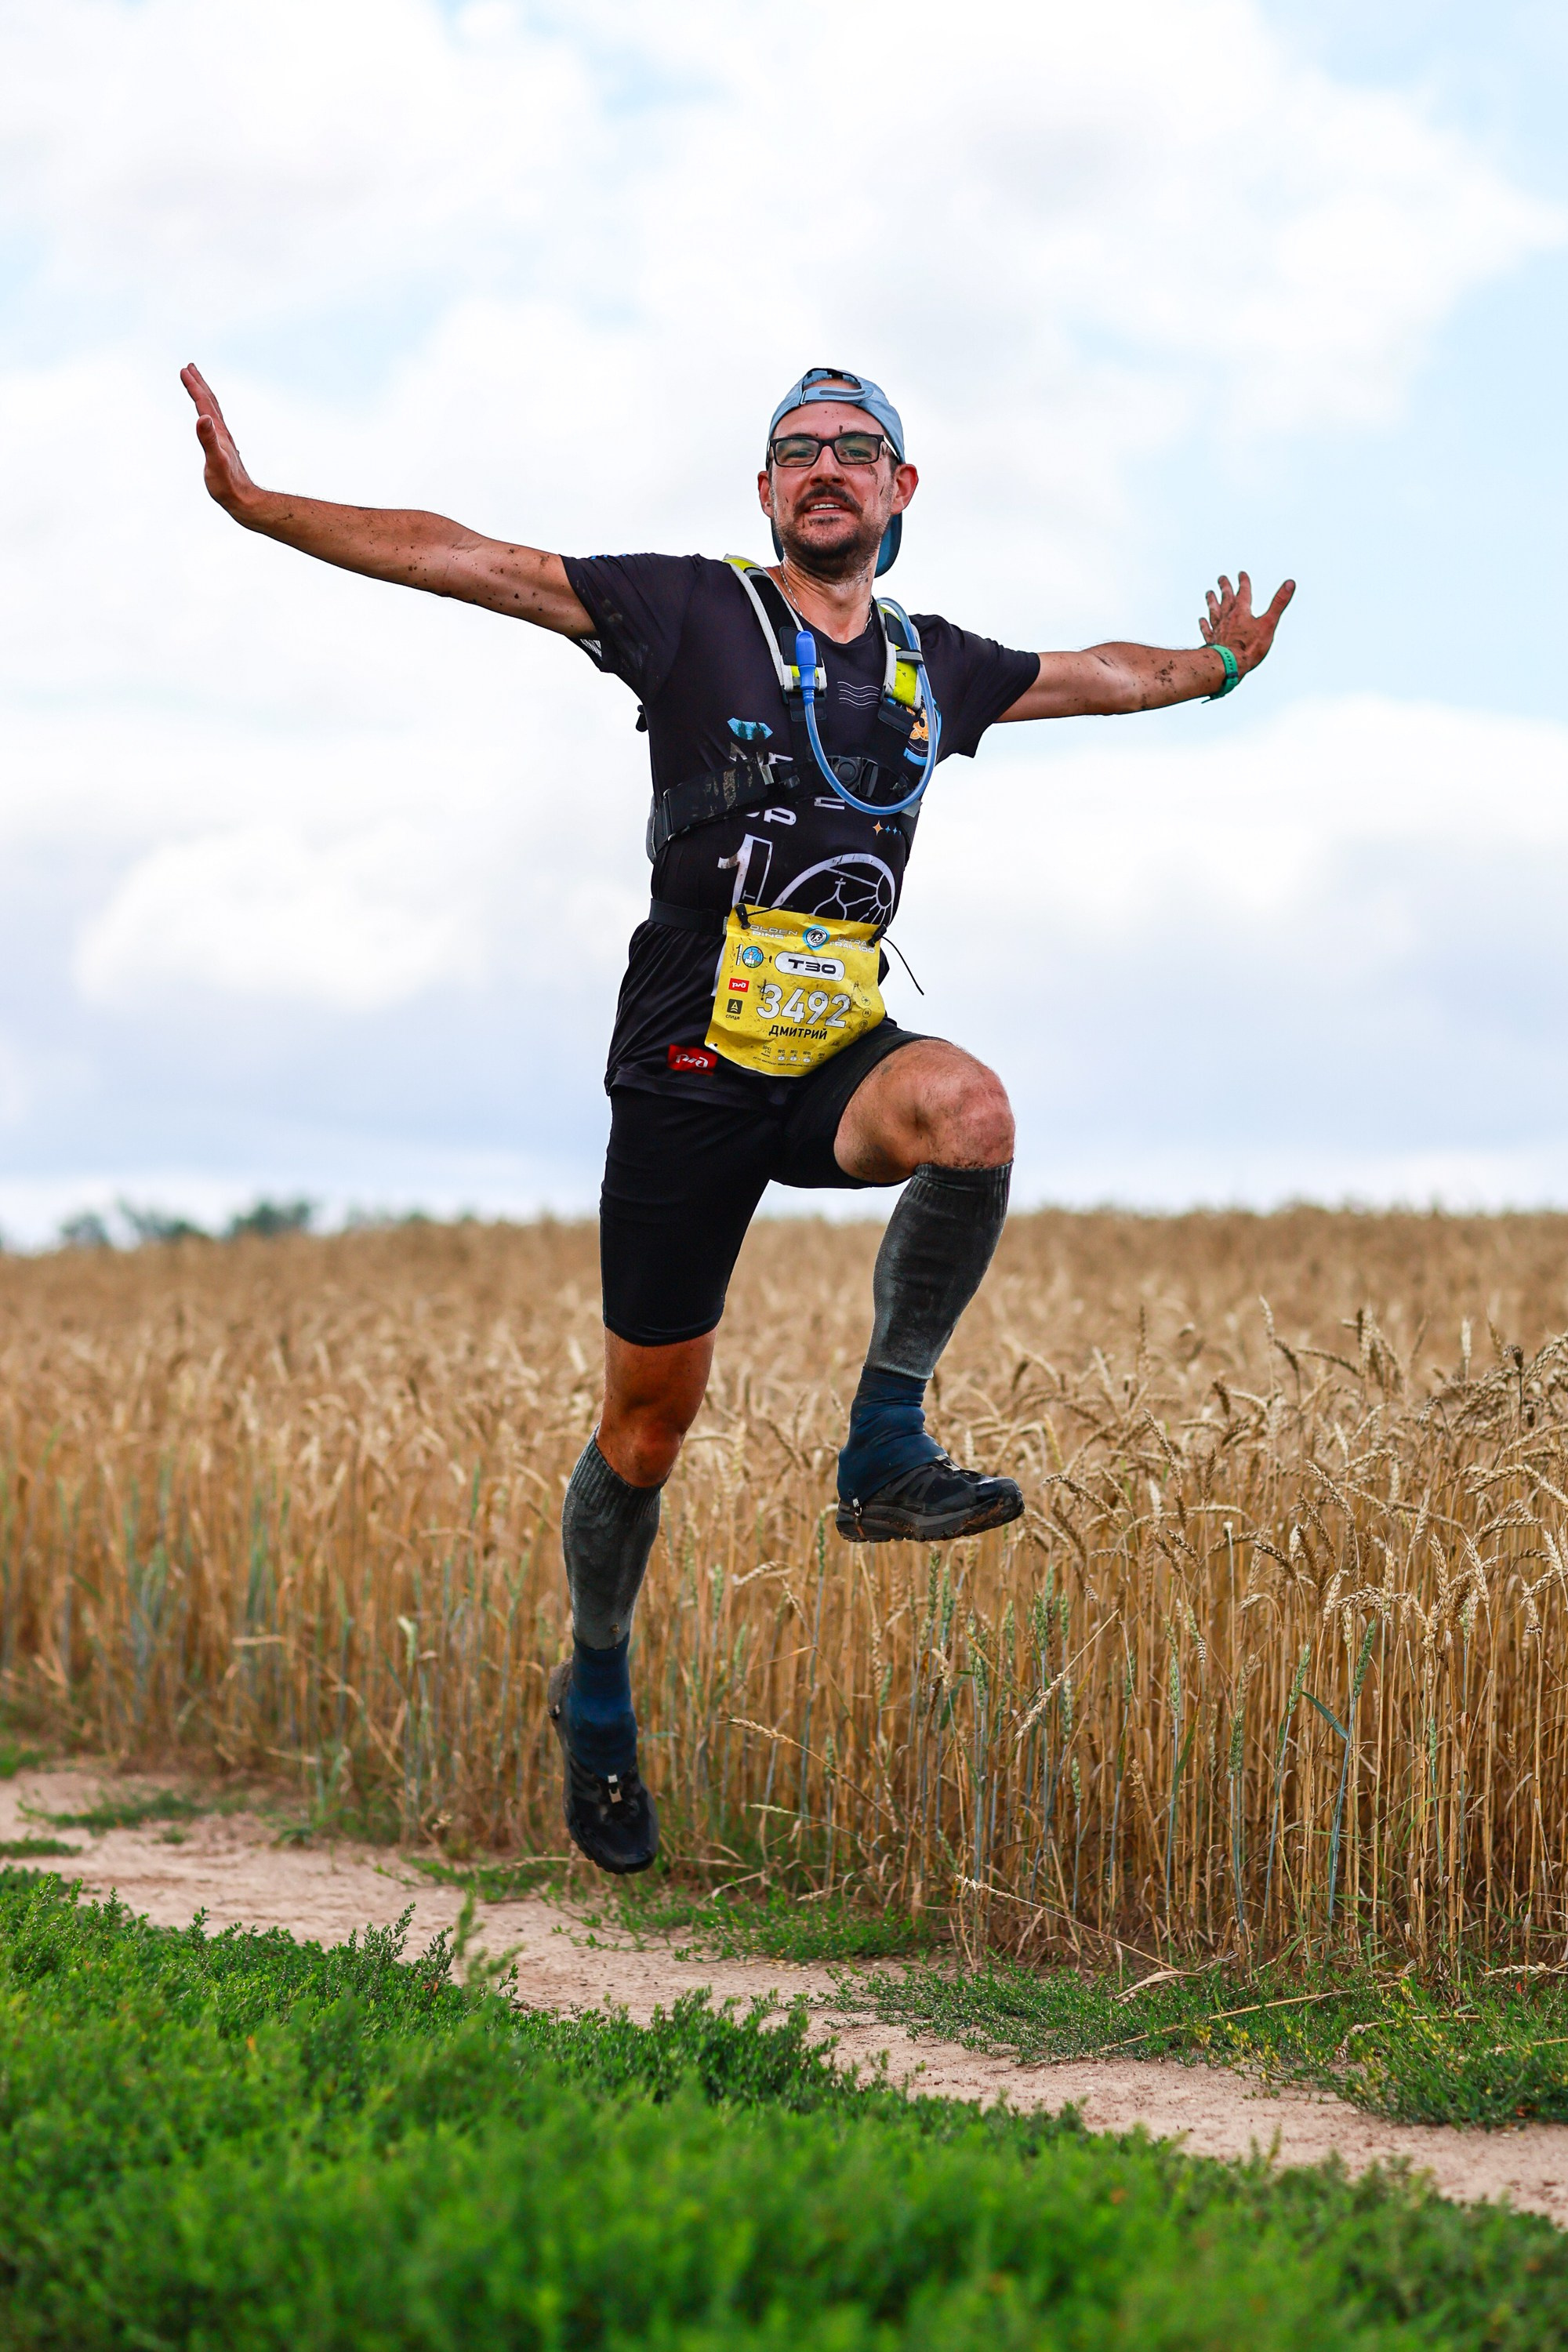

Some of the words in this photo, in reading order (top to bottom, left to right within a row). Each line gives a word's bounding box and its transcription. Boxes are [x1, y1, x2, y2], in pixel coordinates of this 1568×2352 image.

[750, 925, 798, 936] OLDEN
[752, 931, 784, 939] RING
[829, 941, 857, 951] TRAIL
[788, 958, 837, 975] T30
[756, 983, 851, 1029] 3492
[768, 1025, 828, 1040] ДМИТРИЙ
